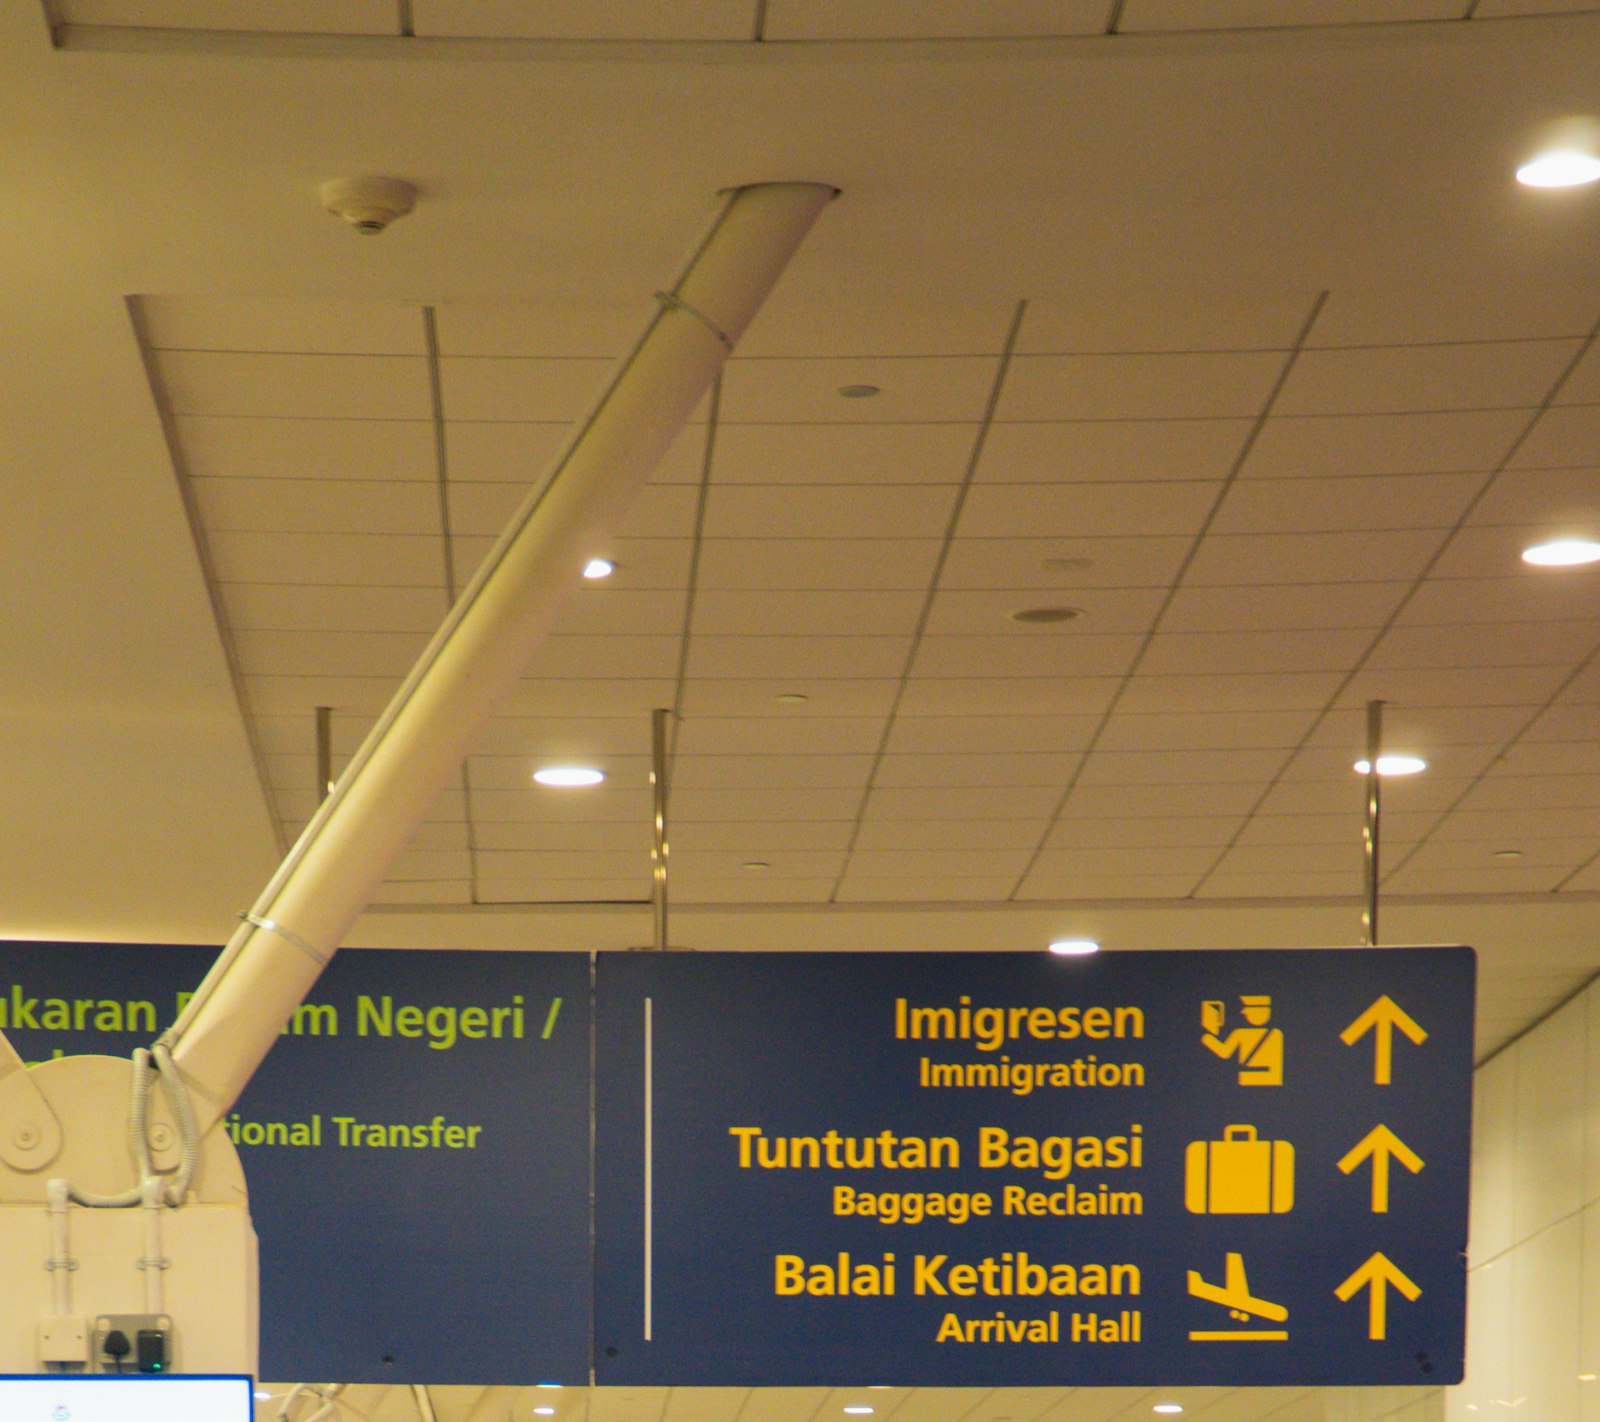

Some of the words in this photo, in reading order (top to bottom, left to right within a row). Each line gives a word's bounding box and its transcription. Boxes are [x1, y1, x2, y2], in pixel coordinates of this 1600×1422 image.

[357, 995, 524, 1050] Negeri
[541, 997, 562, 1039] /
[895, 995, 1145, 1052] Imigresen
[919, 1056, 1145, 1098] Immigration
[331, 1116, 482, 1149] Transfer
[728, 1125, 960, 1169] Tuntutan
[978, 1122, 1143, 1181] Bagasi
[833, 1184, 993, 1225] Baggage
[1003, 1183, 1143, 1217] Reclaim
[774, 1250, 895, 1297] Balai
[913, 1250, 1141, 1297] Ketibaan
[935, 1310, 1059, 1344] Arrival
[1070, 1310, 1141, 1344] Hall
